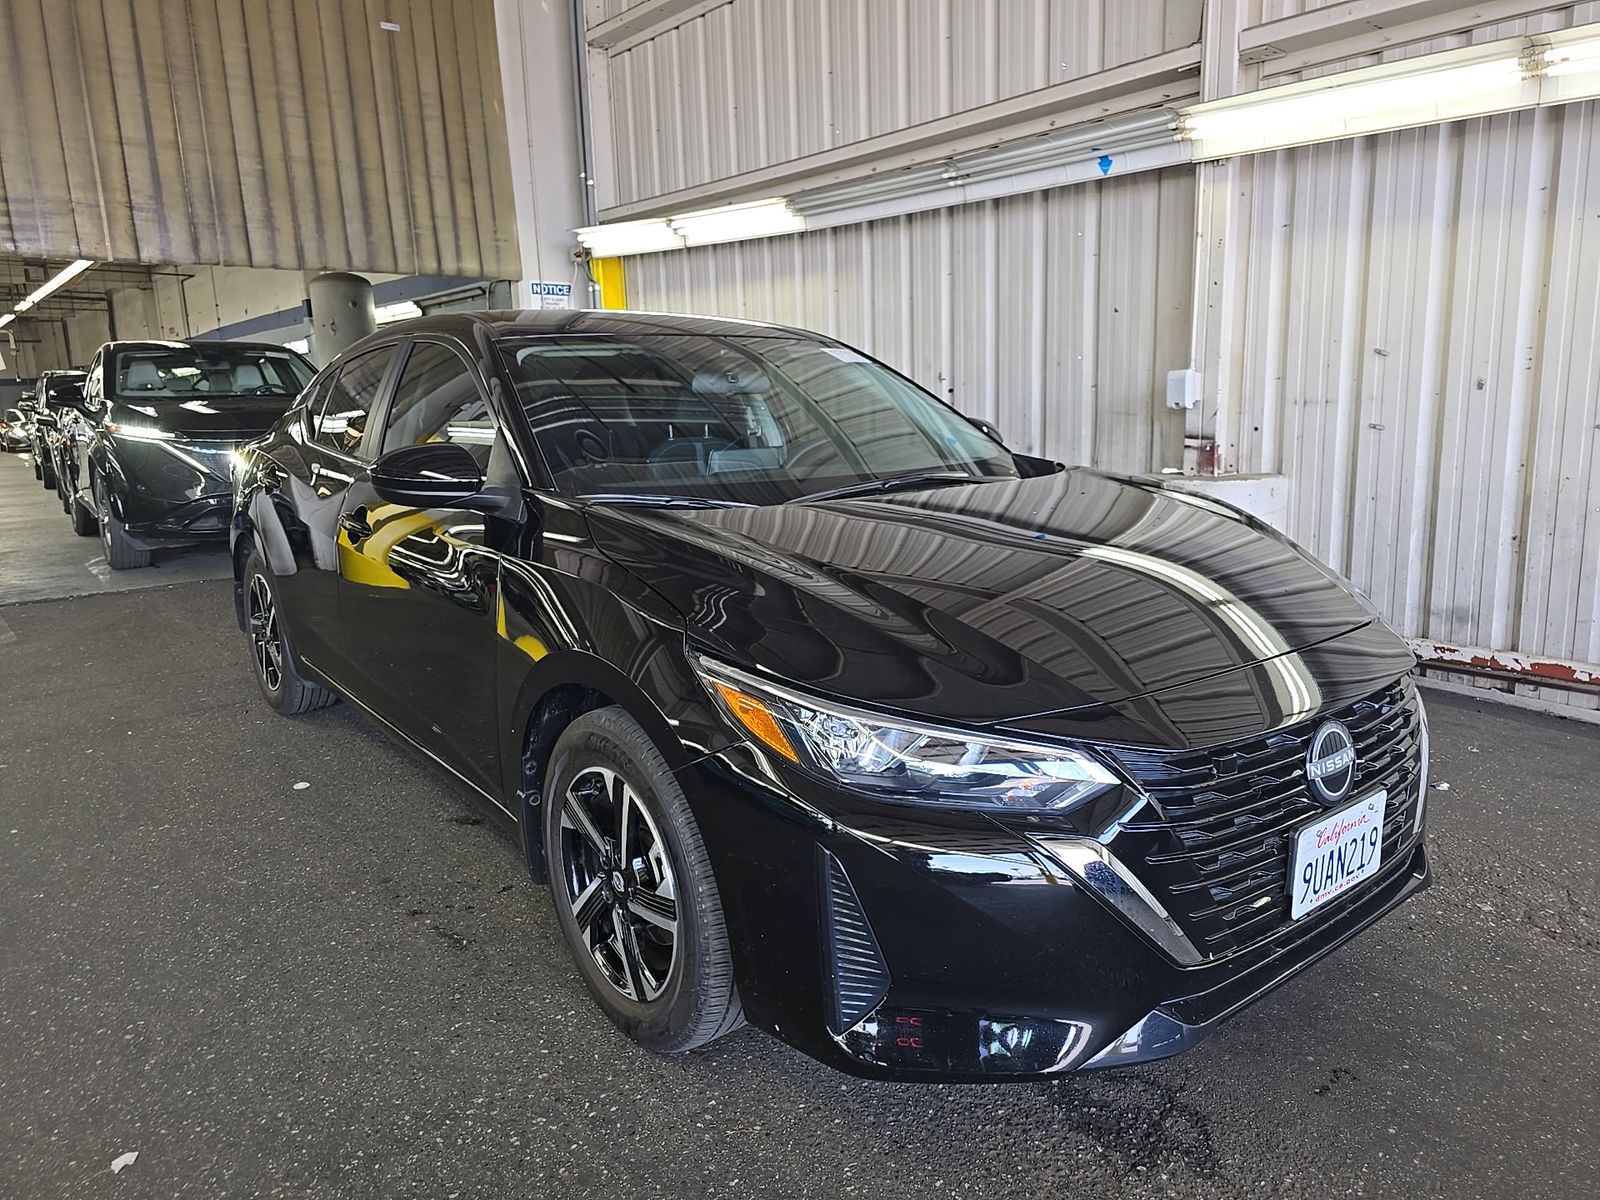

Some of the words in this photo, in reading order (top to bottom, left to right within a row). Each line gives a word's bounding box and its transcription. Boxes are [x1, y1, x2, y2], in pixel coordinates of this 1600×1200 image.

[533, 284, 570, 295] NOTICE
[1310, 748, 1355, 777] NISSAN
[1316, 811, 1371, 849] California
[1300, 826, 1378, 904] 9UAN219
[1315, 873, 1361, 903] dmv.ca.gov
